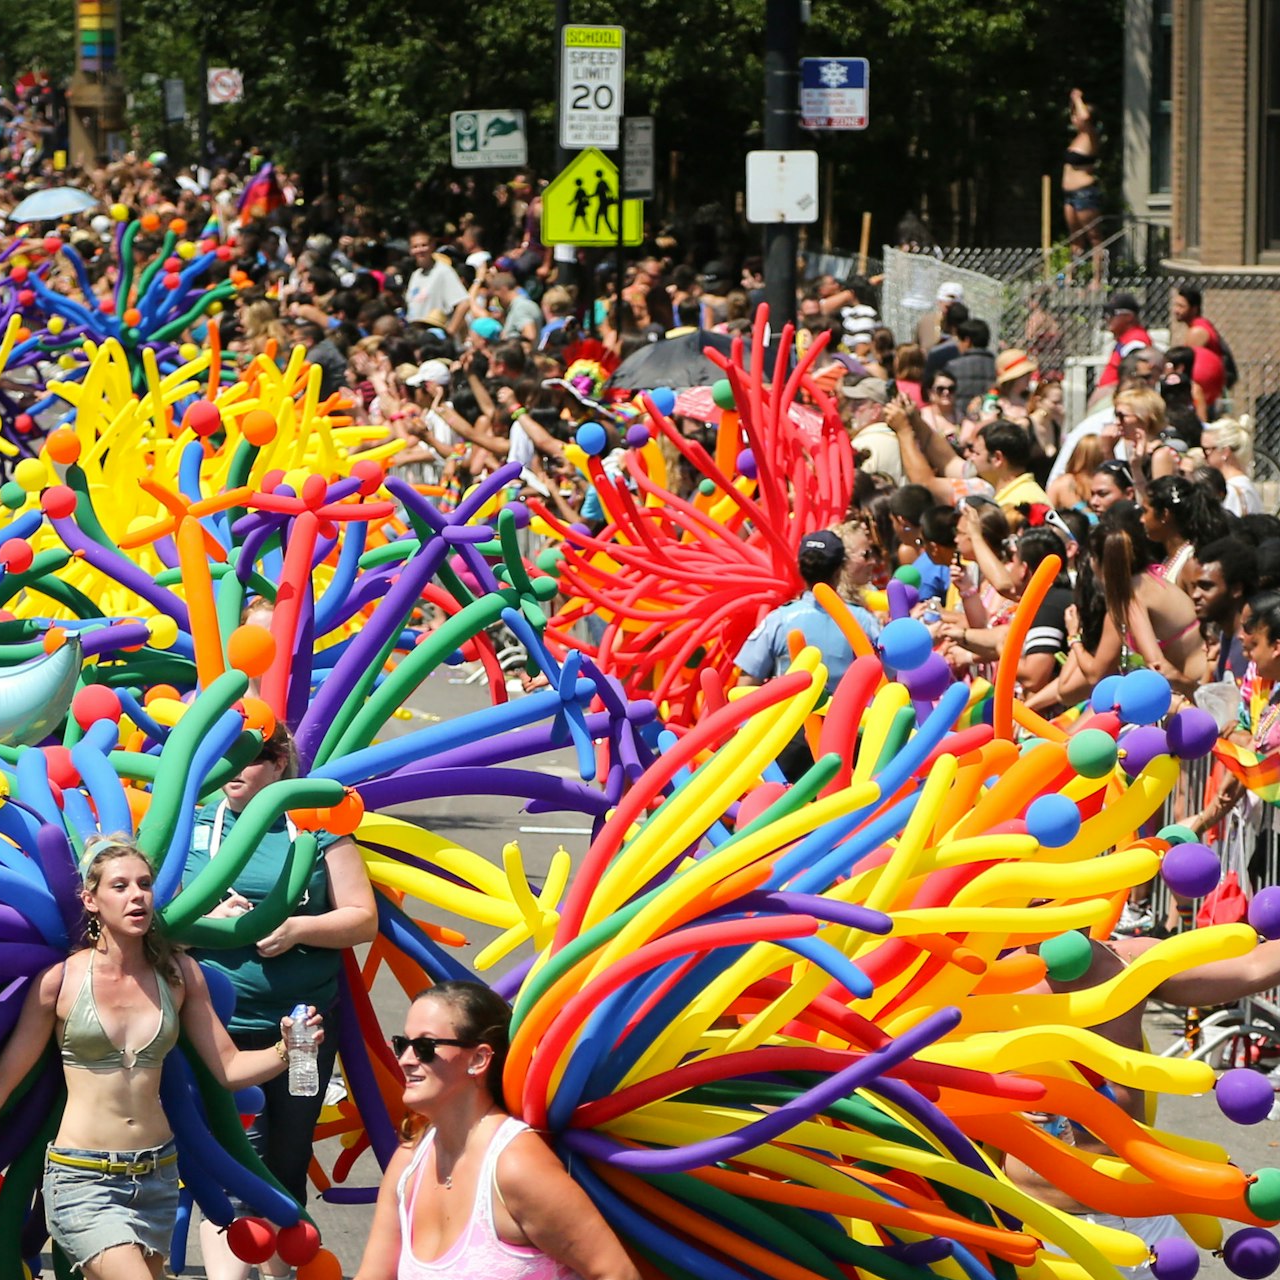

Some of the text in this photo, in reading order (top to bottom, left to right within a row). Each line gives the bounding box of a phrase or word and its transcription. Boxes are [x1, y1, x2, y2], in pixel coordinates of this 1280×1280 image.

[570, 31, 618, 44] SCHOOL
[570, 51, 618, 65] SPEED
[573, 67, 611, 80] LIMIT
[572, 85, 613, 110] 20
